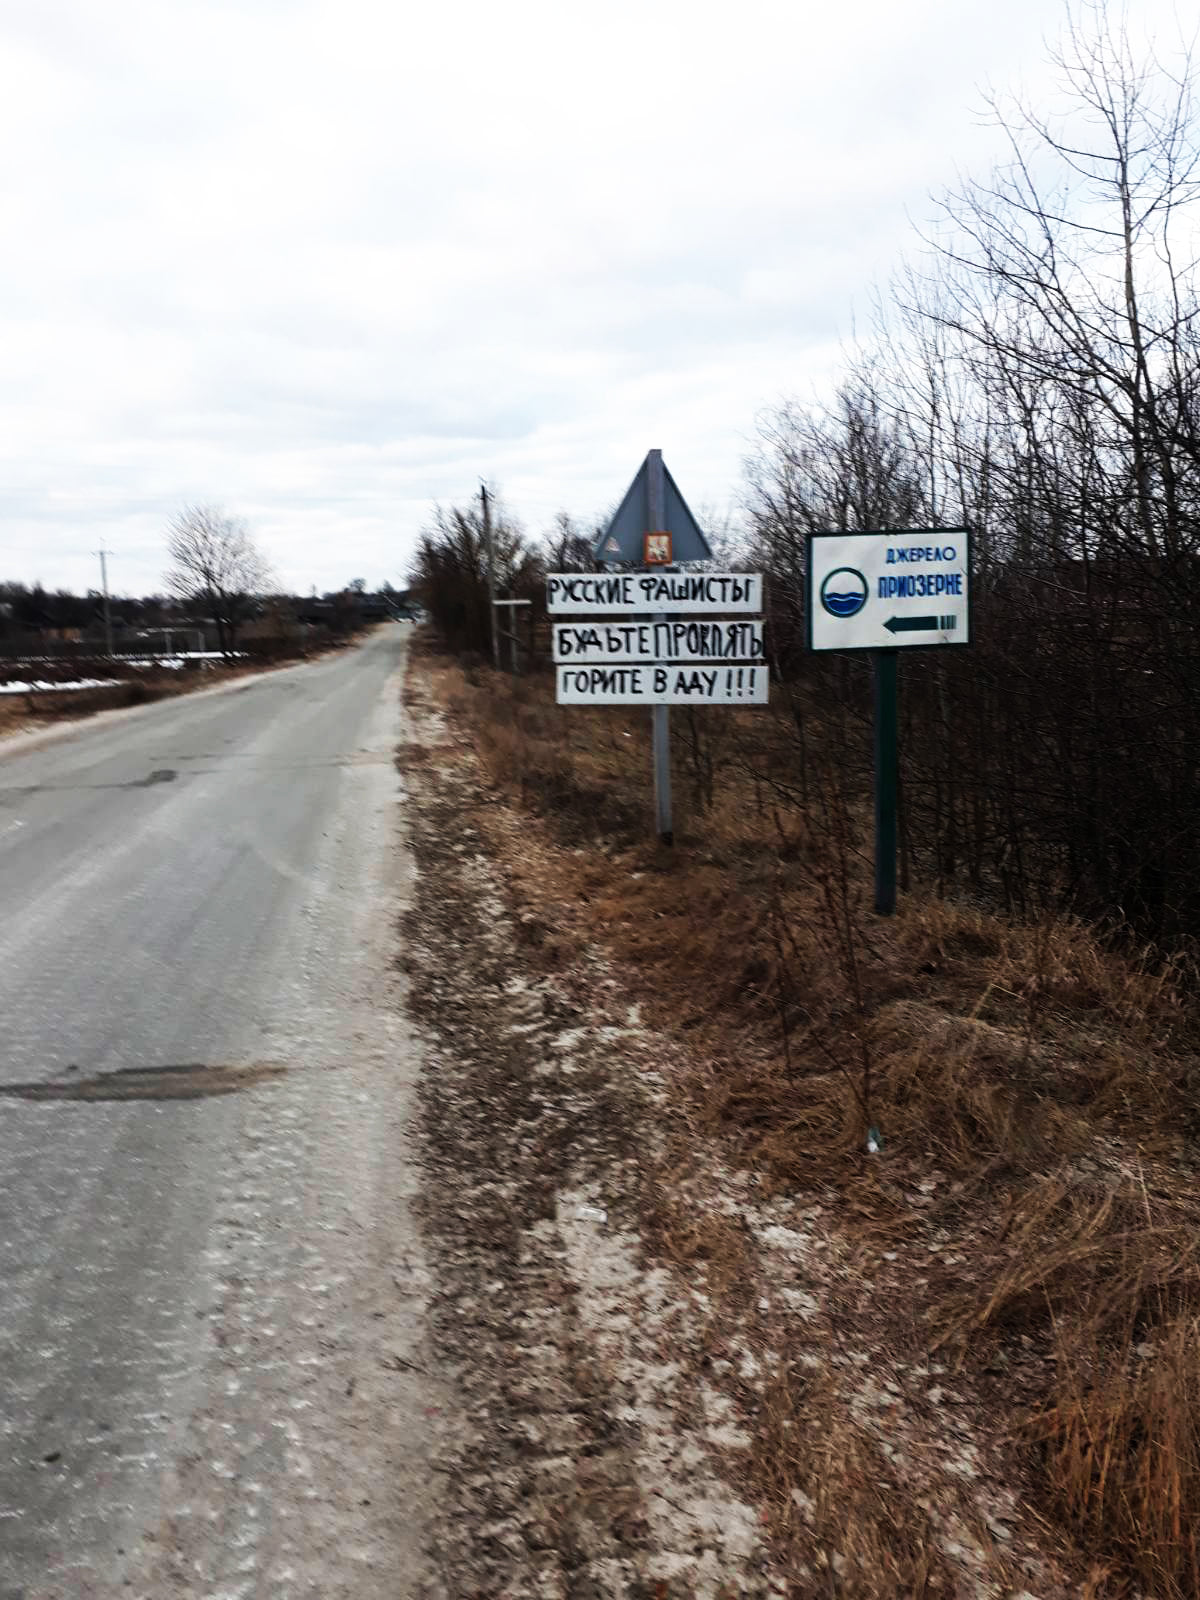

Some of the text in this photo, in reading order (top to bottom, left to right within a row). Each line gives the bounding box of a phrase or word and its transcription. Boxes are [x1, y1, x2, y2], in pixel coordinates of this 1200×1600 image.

[886, 546, 957, 564] ДЖЕРЕЛО
[548, 577, 755, 604] РУССКИЕ ФАШИСТЫ
[877, 574, 963, 599] ПРИОЗЕРНЕ
[558, 627, 650, 657] БУДЬТЕ
[563, 669, 644, 695] ГОРИТЕ
[653, 668, 668, 694] В
